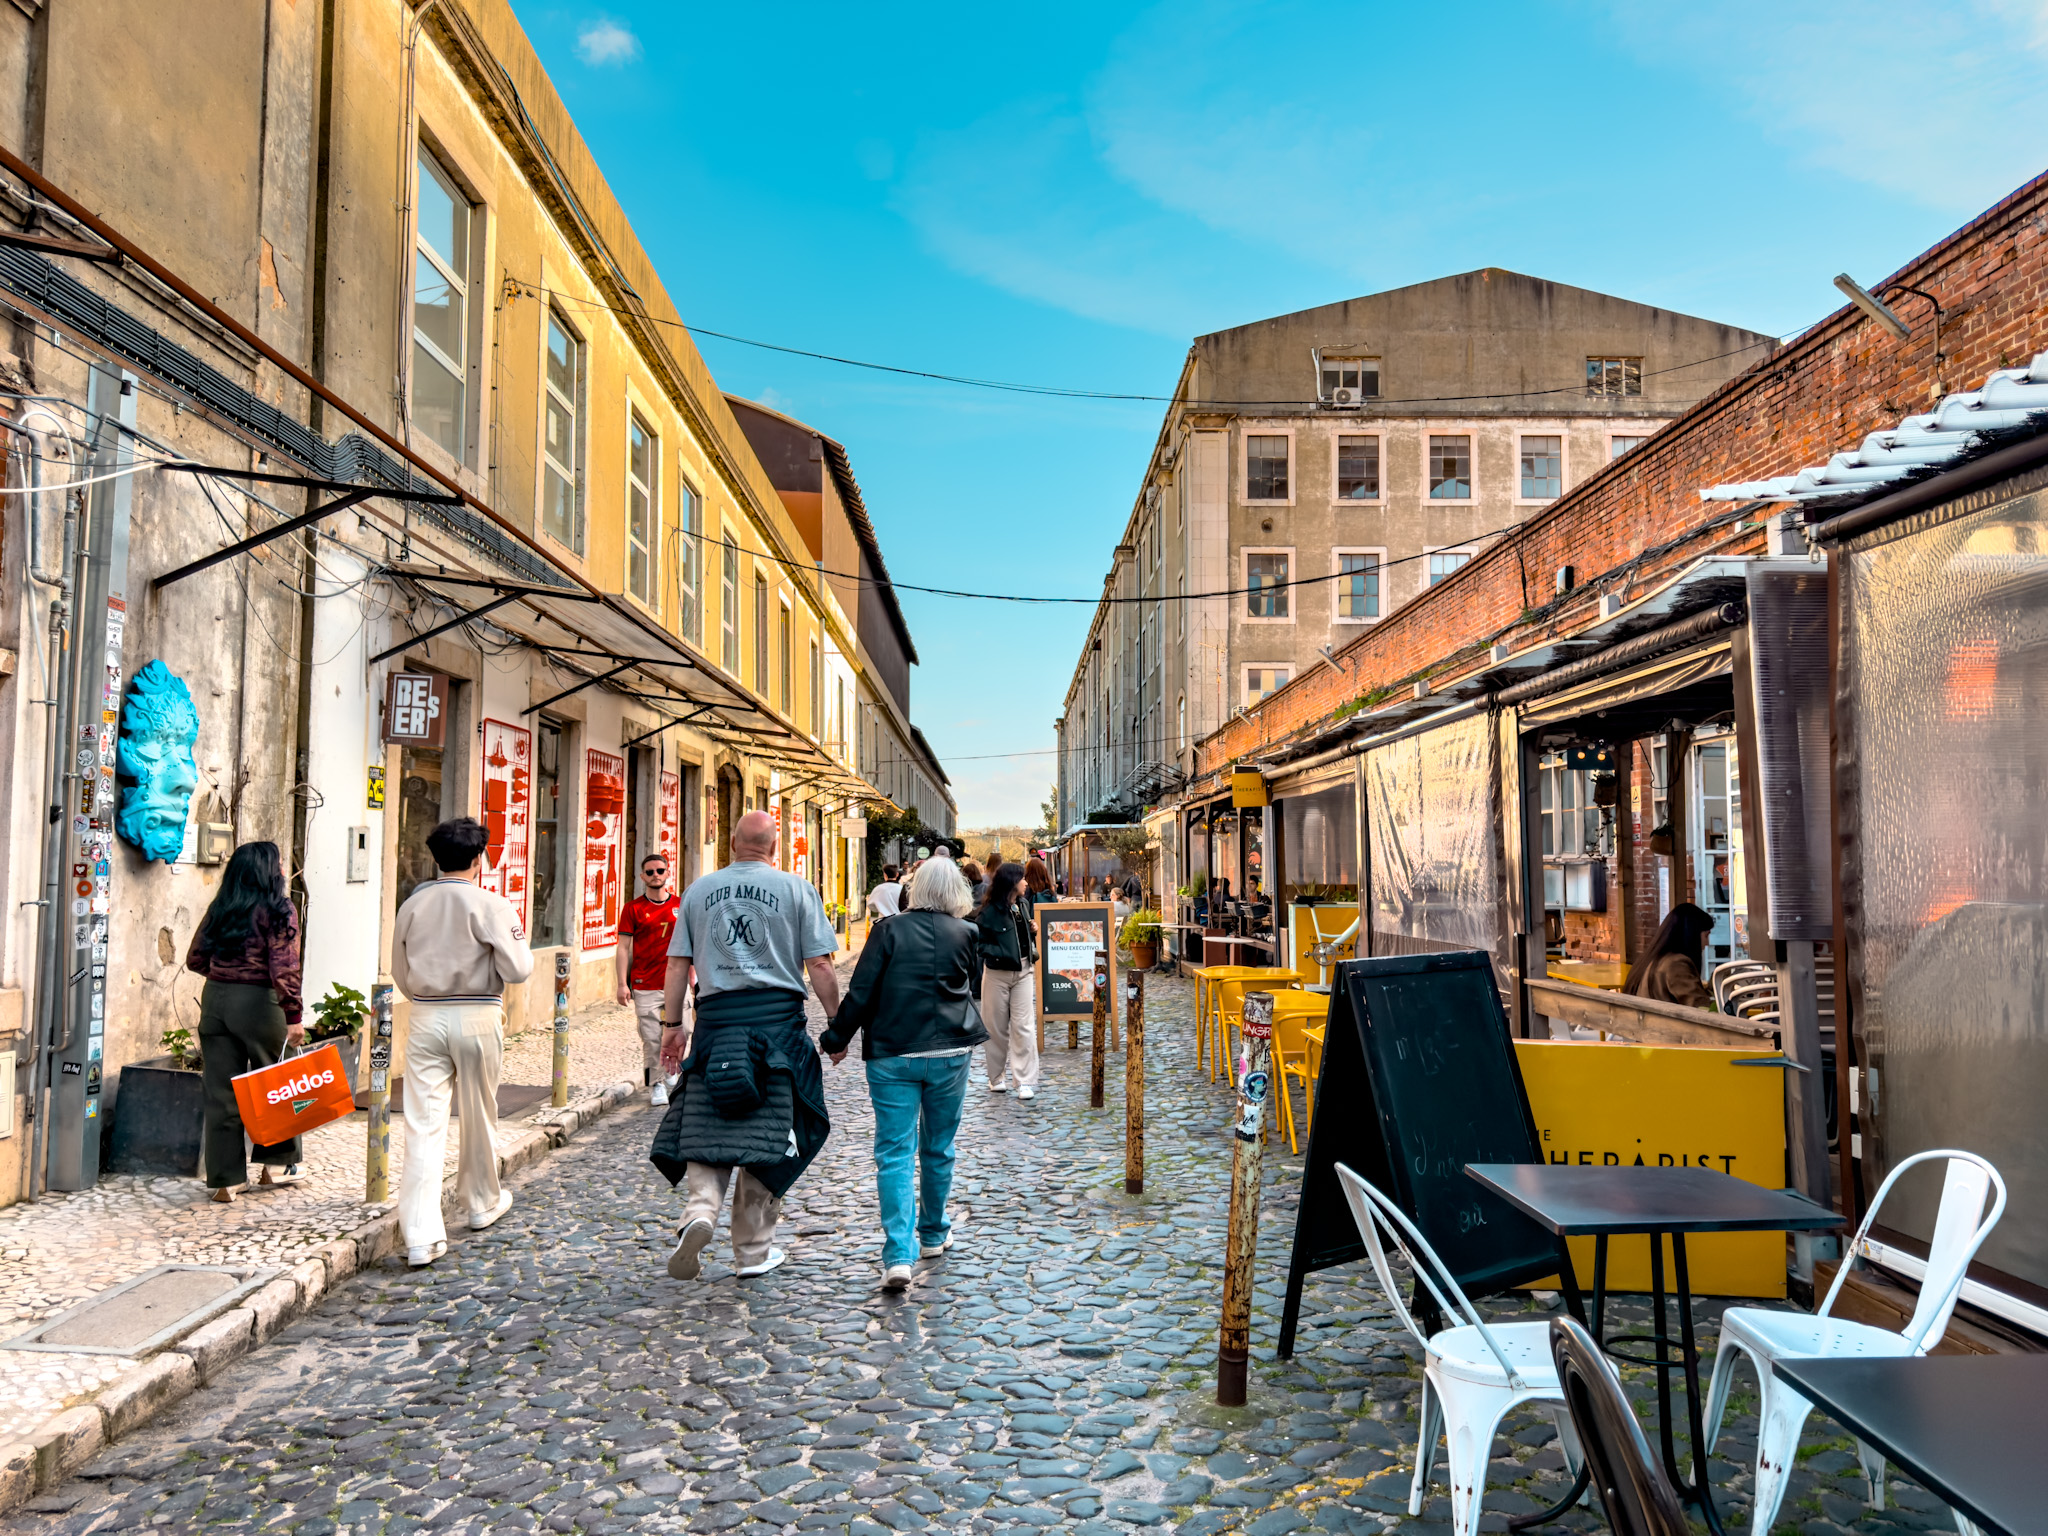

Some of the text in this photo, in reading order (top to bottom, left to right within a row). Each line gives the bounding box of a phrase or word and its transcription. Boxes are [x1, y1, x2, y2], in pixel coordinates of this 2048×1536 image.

[705, 884, 780, 913] CLUB AMALFI
[660, 922, 669, 938] 7
[267, 1070, 335, 1105] saldos
